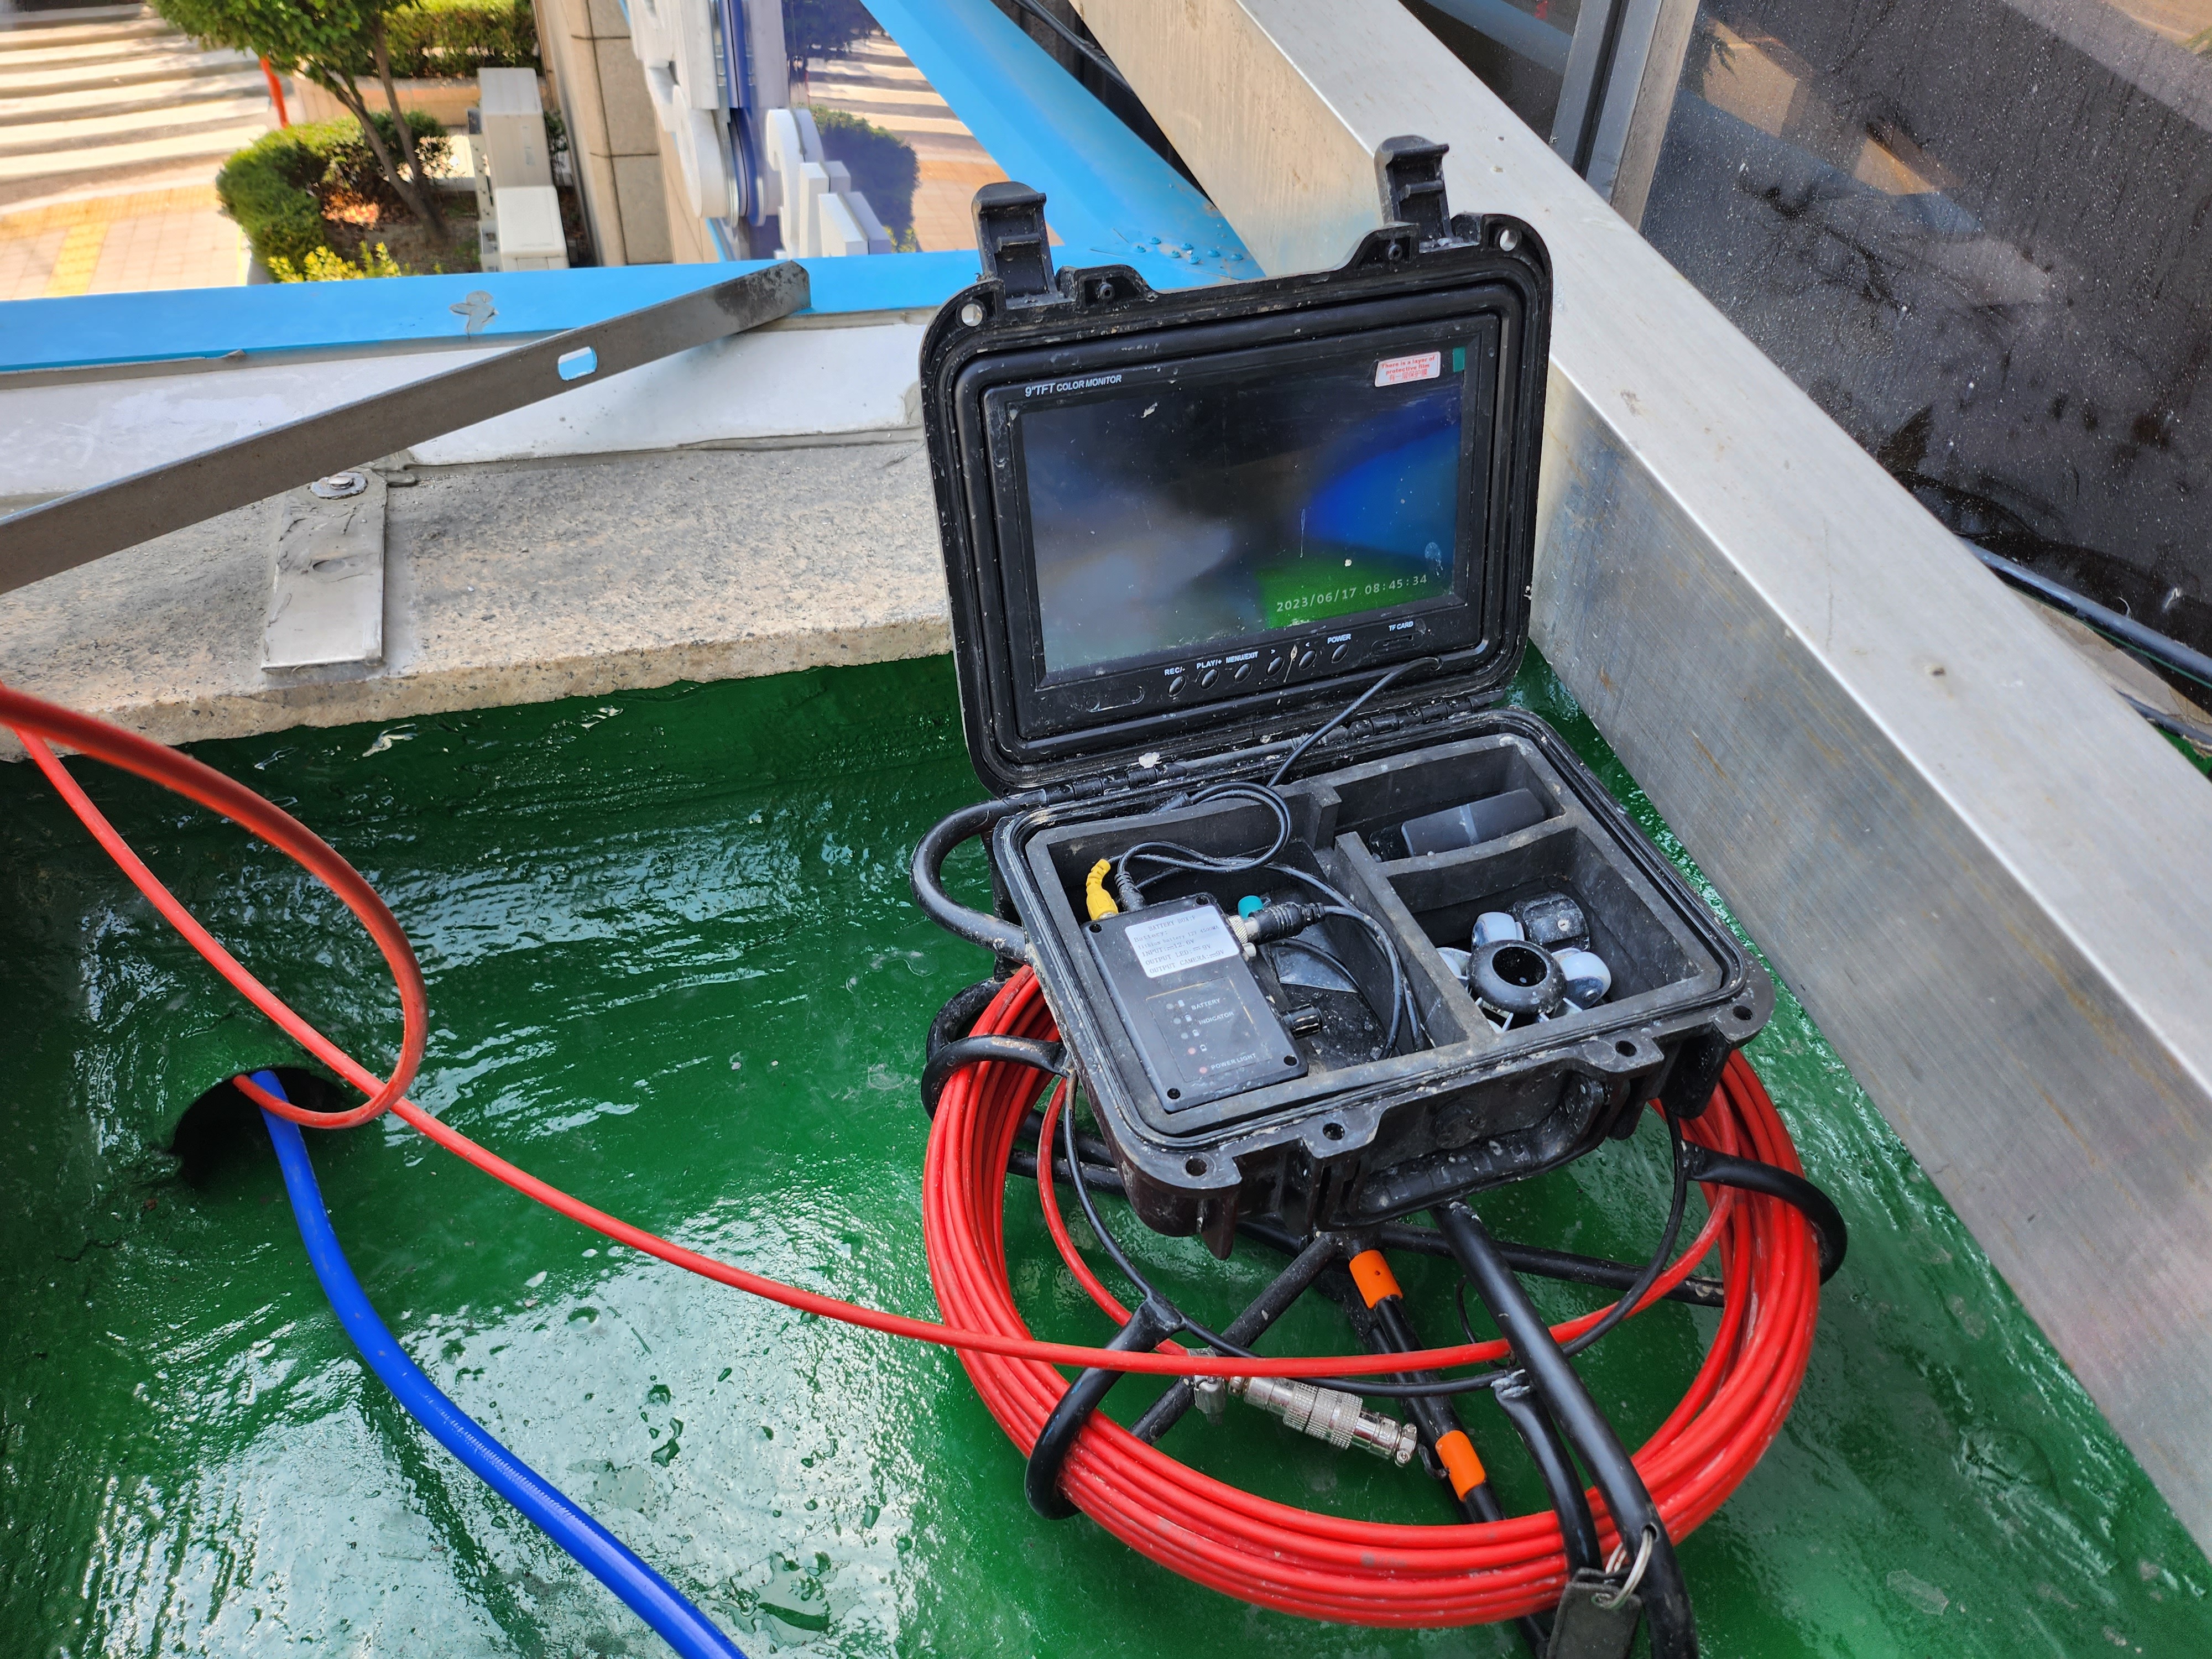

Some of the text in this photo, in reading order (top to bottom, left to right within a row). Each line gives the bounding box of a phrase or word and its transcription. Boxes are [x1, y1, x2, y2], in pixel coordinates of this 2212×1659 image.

[1386, 366, 1417, 375] protective
[1056, 380, 1084, 392] COLOR
[1086, 374, 1122, 388] MONITOR
[1276, 575, 1427, 612] 2023/06/17 08:45:34
[1397, 621, 1414, 629] CARD
[1327, 633, 1352, 644] POWER
[1225, 651, 1259, 664] MENU/EXIT
[1196, 659, 1222, 670] PLAY/+
[1148, 920, 1175, 931] BATTERY
[1134, 931, 1168, 942] Battery:
[1162, 935, 1185, 943] battery
[1145, 954, 1171, 966] OUTPUT
[1149, 963, 1176, 974] OUTPUT
[1191, 998, 1221, 1010] BATTERY
[1198, 1011, 1234, 1025] INDICATOR
[1211, 1053, 1257, 1070] POWER LIGHT
